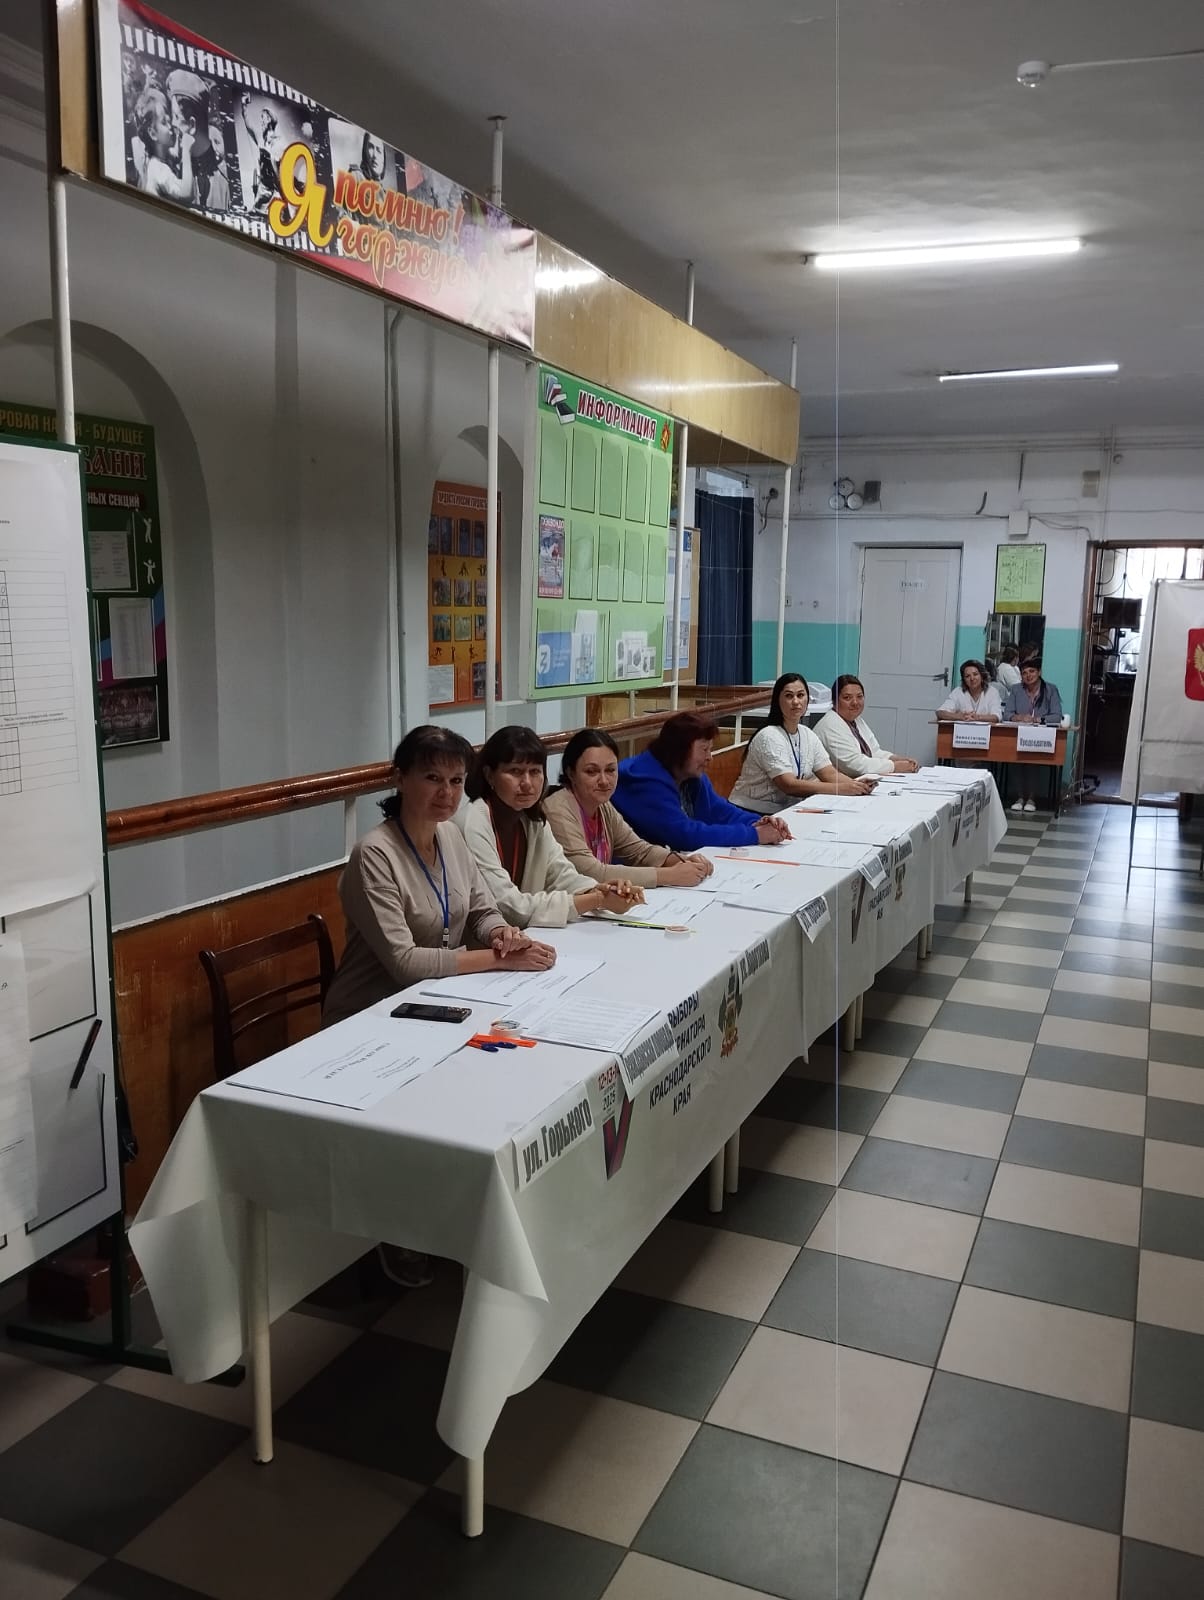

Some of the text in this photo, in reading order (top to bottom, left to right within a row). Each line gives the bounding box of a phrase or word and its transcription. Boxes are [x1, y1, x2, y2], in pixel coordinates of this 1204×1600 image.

[268, 141, 334, 248] Я
[93, 423, 144, 446] БУДУЩЕЕ
[577, 388, 658, 442] ИНФОРМАЦИЯ
[109, 492, 140, 509] СЕКЦИЙ
[649, 1035, 712, 1110] КРАСНОДАРСКОГО
[673, 1083, 691, 1116] КРАЯ
[522, 1098, 593, 1183] ул. Горького
